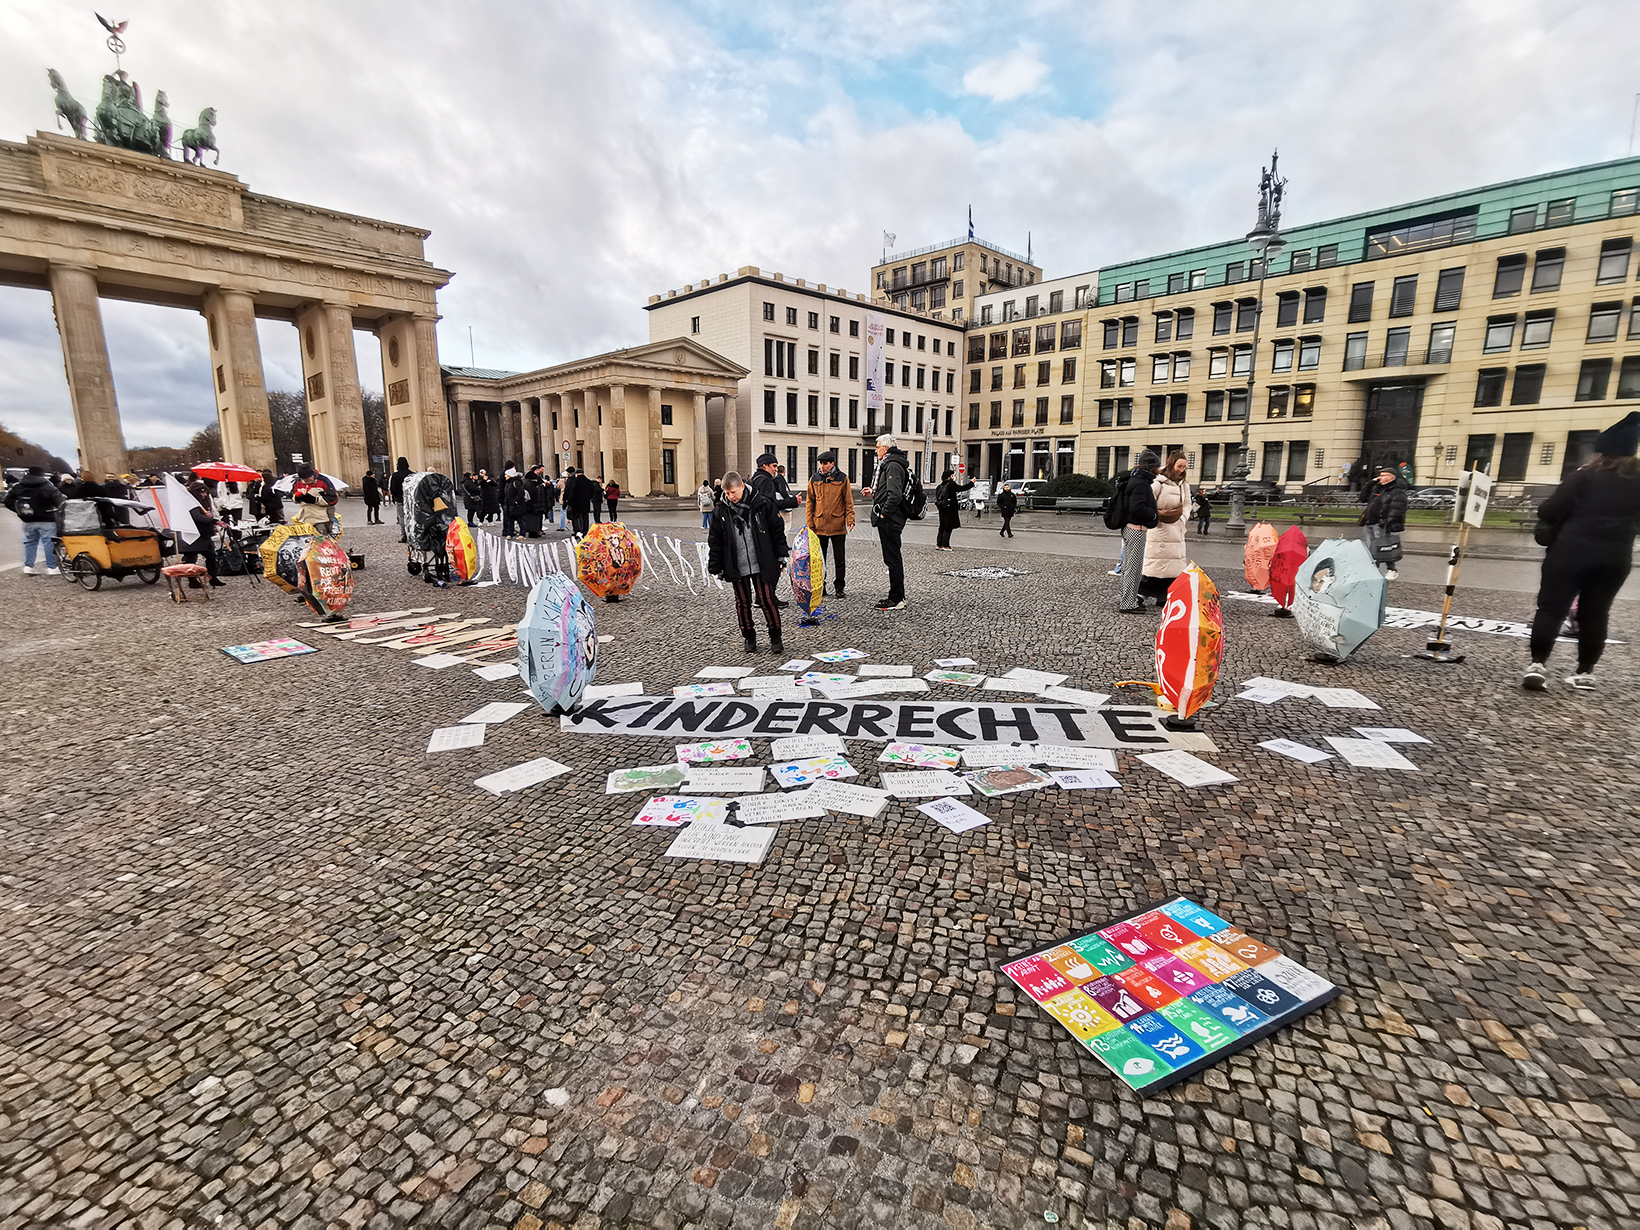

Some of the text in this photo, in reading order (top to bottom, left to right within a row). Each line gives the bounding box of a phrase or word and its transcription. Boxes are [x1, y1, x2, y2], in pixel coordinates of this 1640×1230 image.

[570, 697, 1169, 744] KINDERRECHTE
[702, 832, 721, 840] KIND
[1130, 918, 1141, 929] 5
[1100, 930, 1115, 941] 4
[1069, 943, 1084, 952] 3
[1043, 954, 1057, 963] 2
[1007, 959, 1032, 977] 1 KEINE
[1114, 975, 1126, 984] 9
[1222, 979, 1237, 990] 17
[1083, 984, 1097, 996] 8
[1044, 1003, 1062, 1015] 7
[1130, 1022, 1145, 1034] 14
[1091, 1039, 1110, 1052] 13
